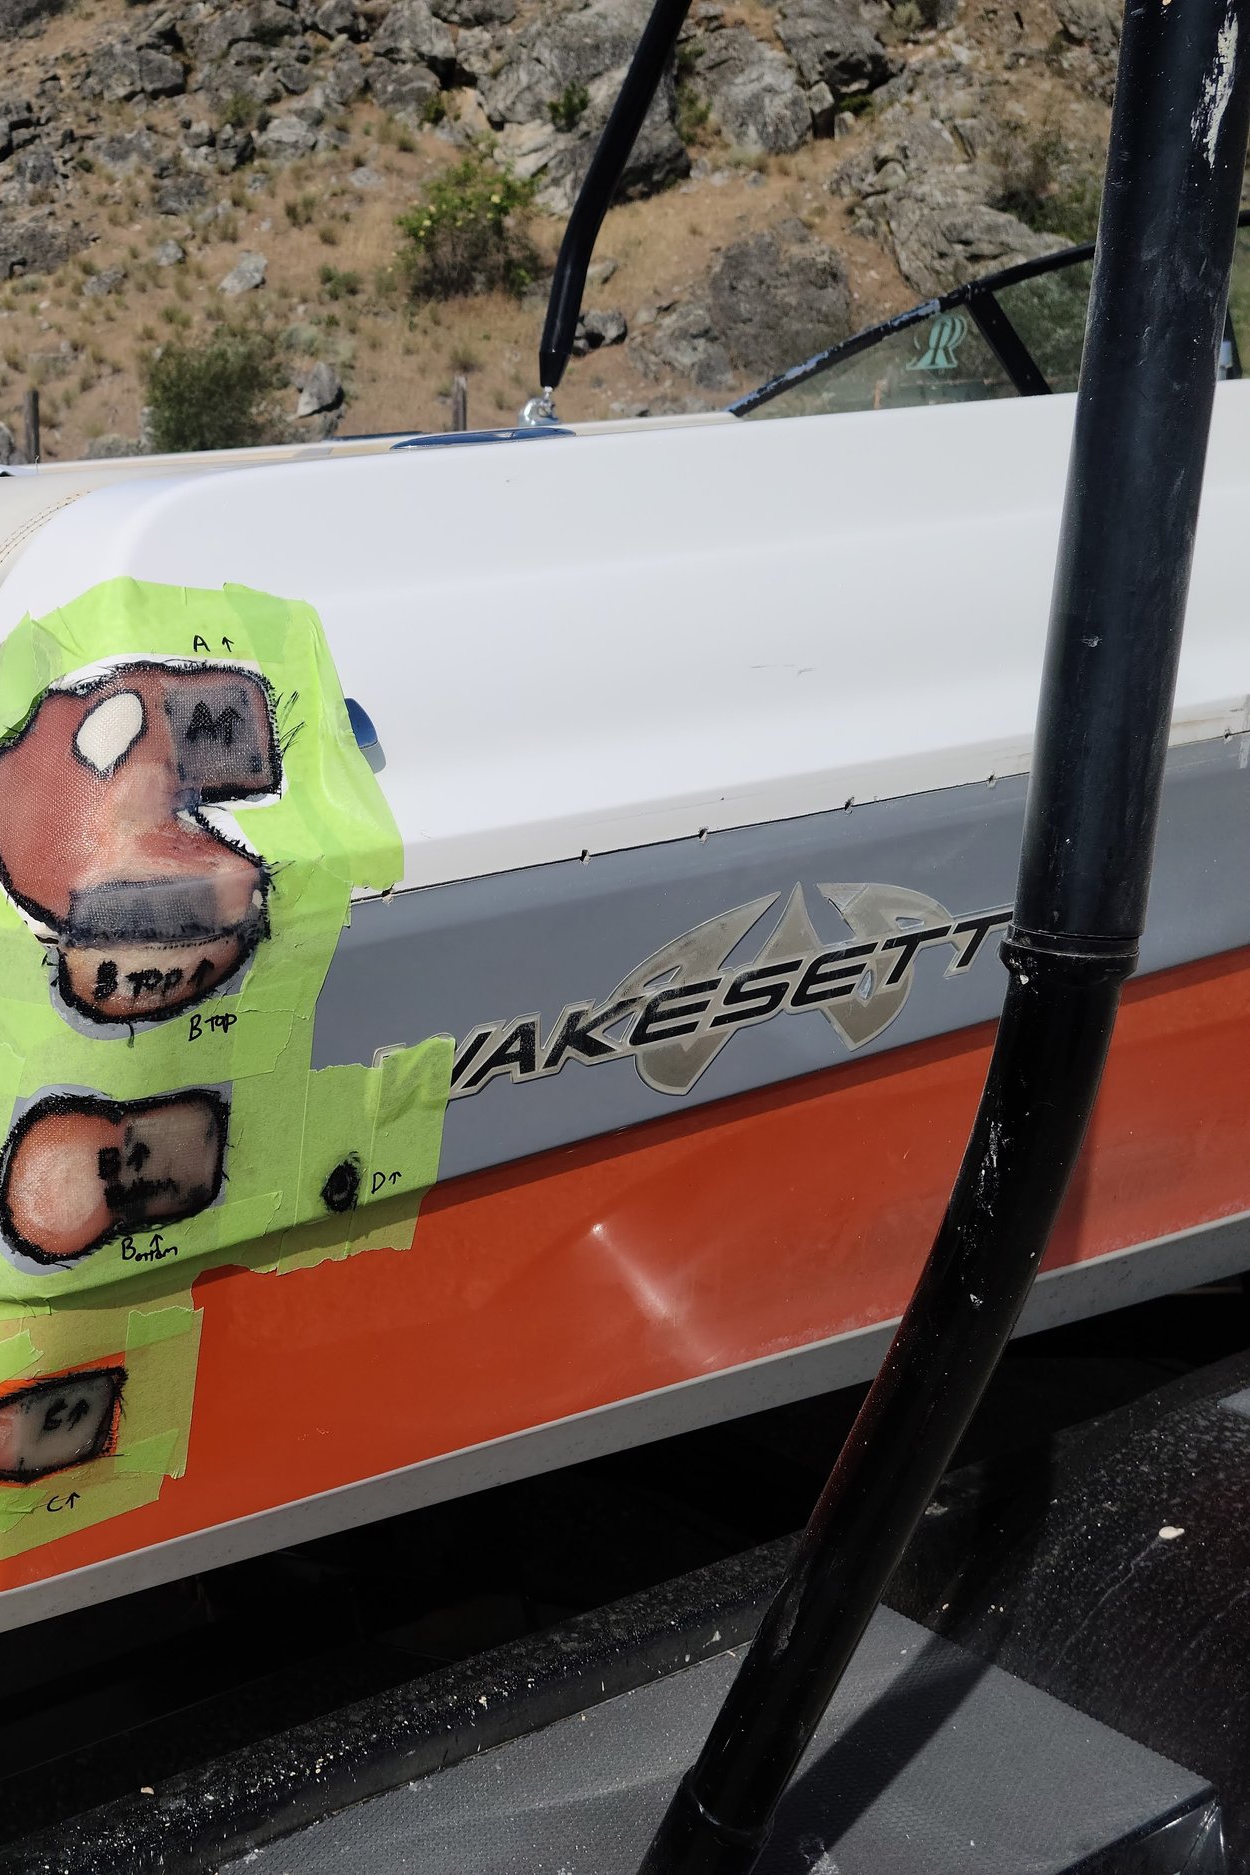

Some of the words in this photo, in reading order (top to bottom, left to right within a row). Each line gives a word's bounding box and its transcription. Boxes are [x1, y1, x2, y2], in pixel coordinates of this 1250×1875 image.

[193, 634, 211, 653] A
[451, 910, 1013, 1090] AKESETT
[188, 1014, 202, 1041] B
[371, 1171, 386, 1194] D
[46, 1495, 63, 1512] C
